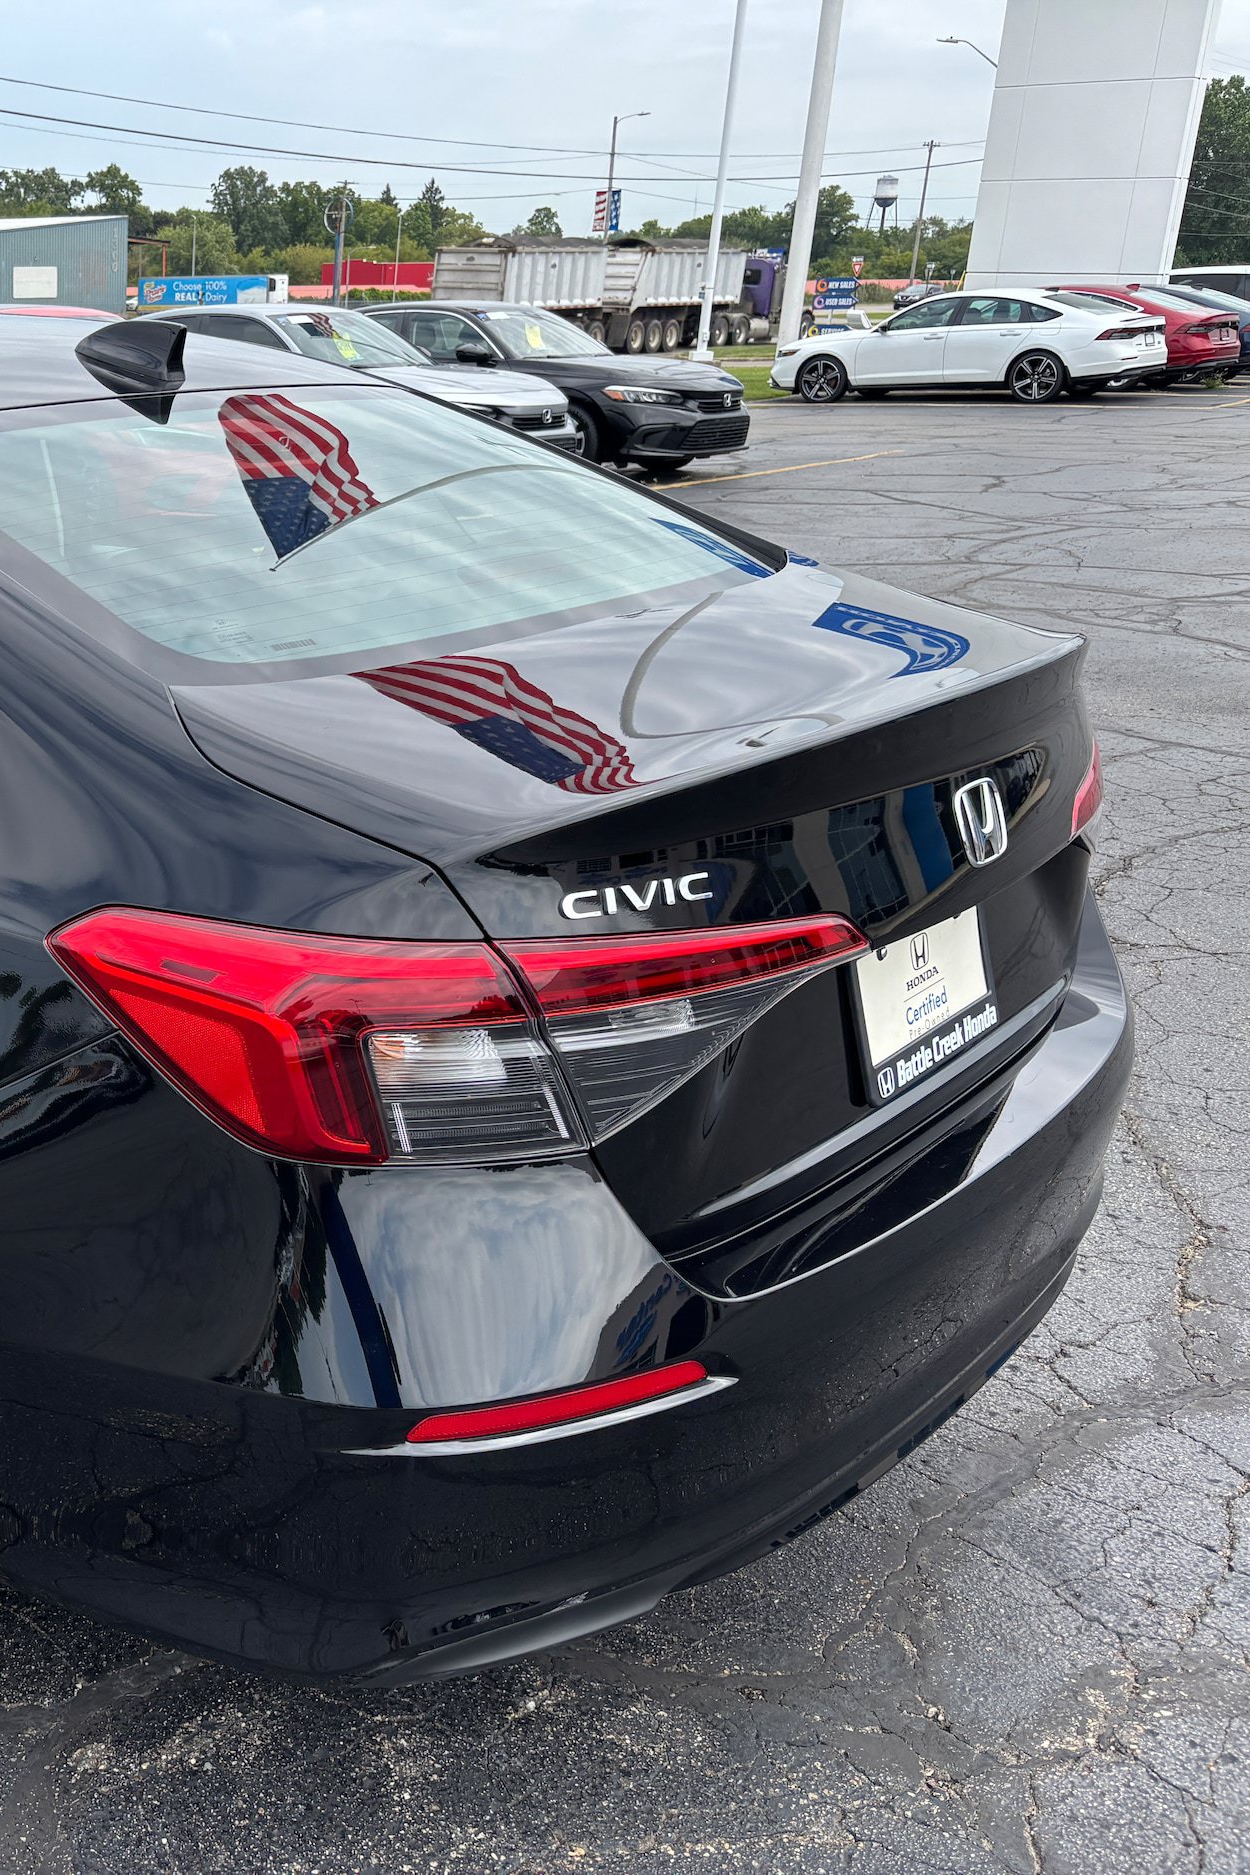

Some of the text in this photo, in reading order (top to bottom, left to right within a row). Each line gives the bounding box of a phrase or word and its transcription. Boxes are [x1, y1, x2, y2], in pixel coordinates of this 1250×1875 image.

[173, 281, 227, 290] Choose 100%
[175, 293, 227, 303] REAL Dairy
[561, 871, 714, 920] CIVIC
[906, 966, 939, 991] HONDA
[906, 985, 948, 1025] Certified
[909, 1007, 950, 1040] Pre-Owned
[896, 1003, 998, 1087] Battle Creek Honda
